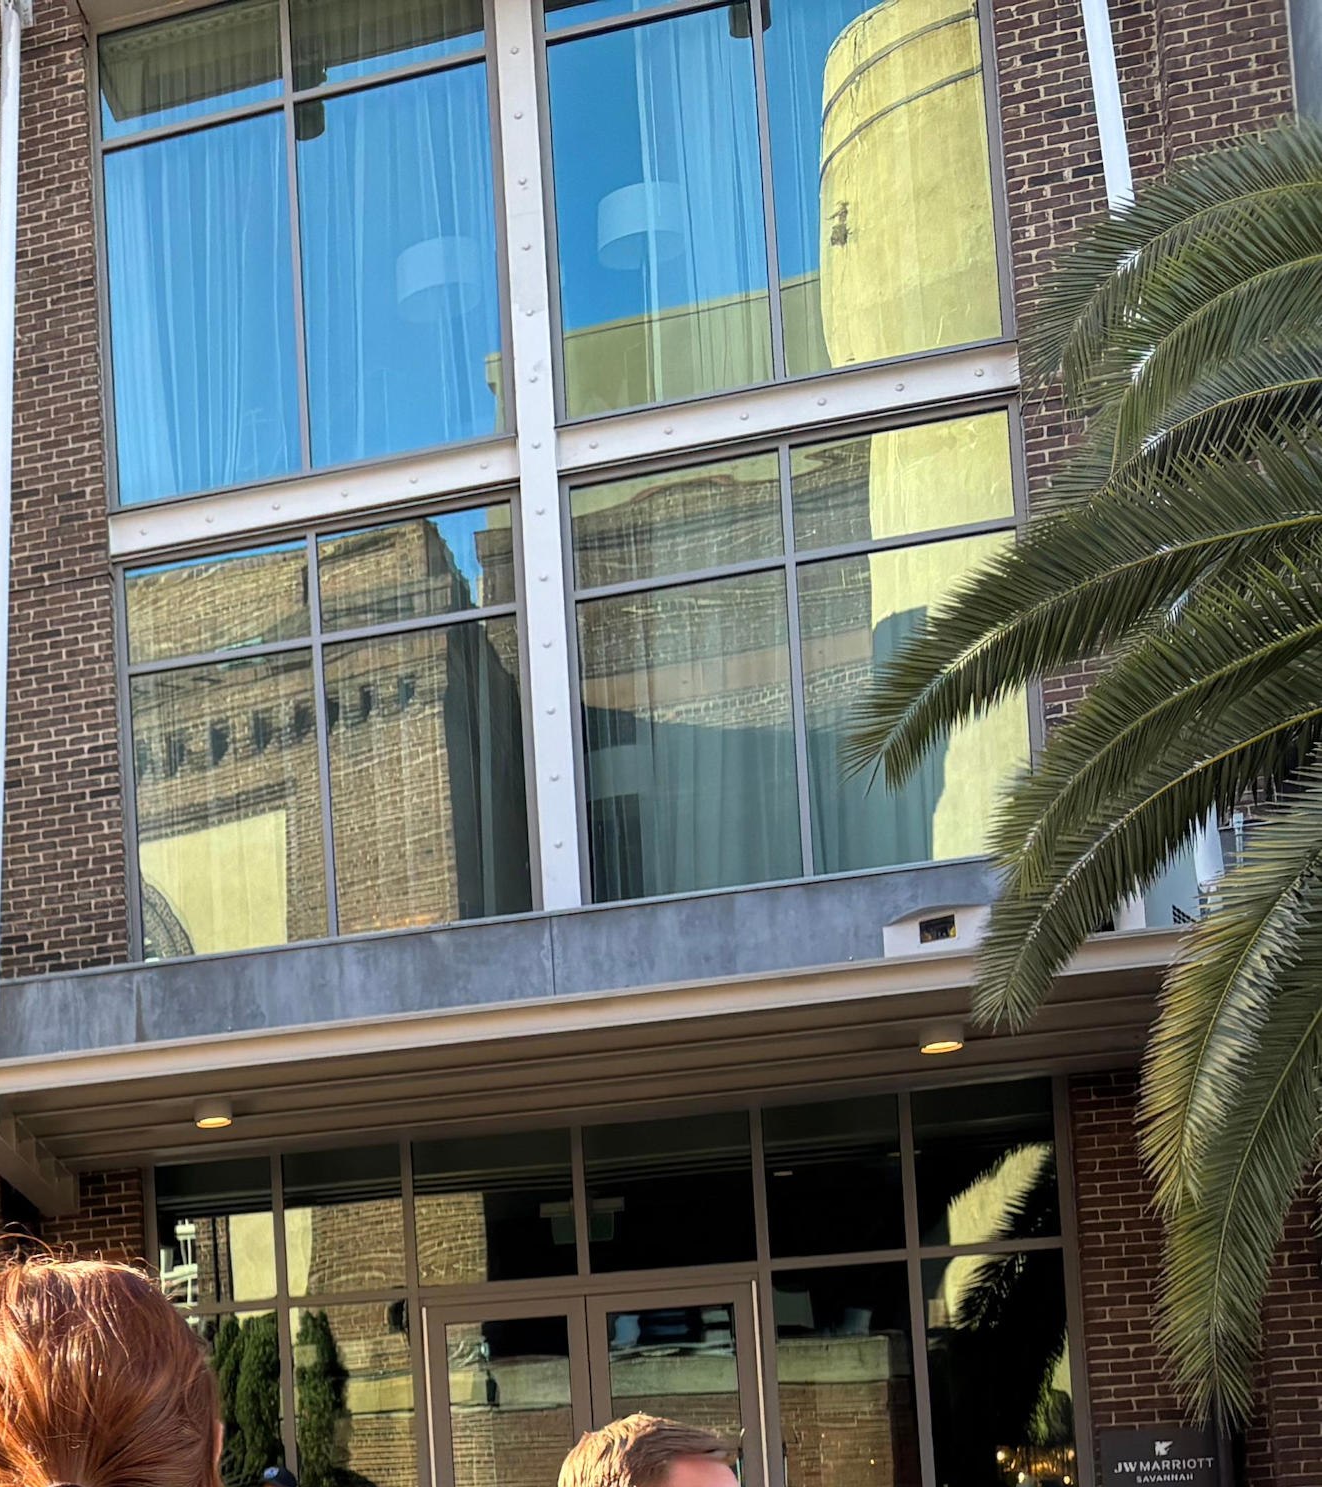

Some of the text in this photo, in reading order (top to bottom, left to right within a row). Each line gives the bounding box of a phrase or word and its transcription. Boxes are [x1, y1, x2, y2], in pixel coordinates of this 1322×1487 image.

[1113, 1457, 1214, 1474] JW MARRIOTT
[1136, 1473, 1194, 1484] SAVANNAH
